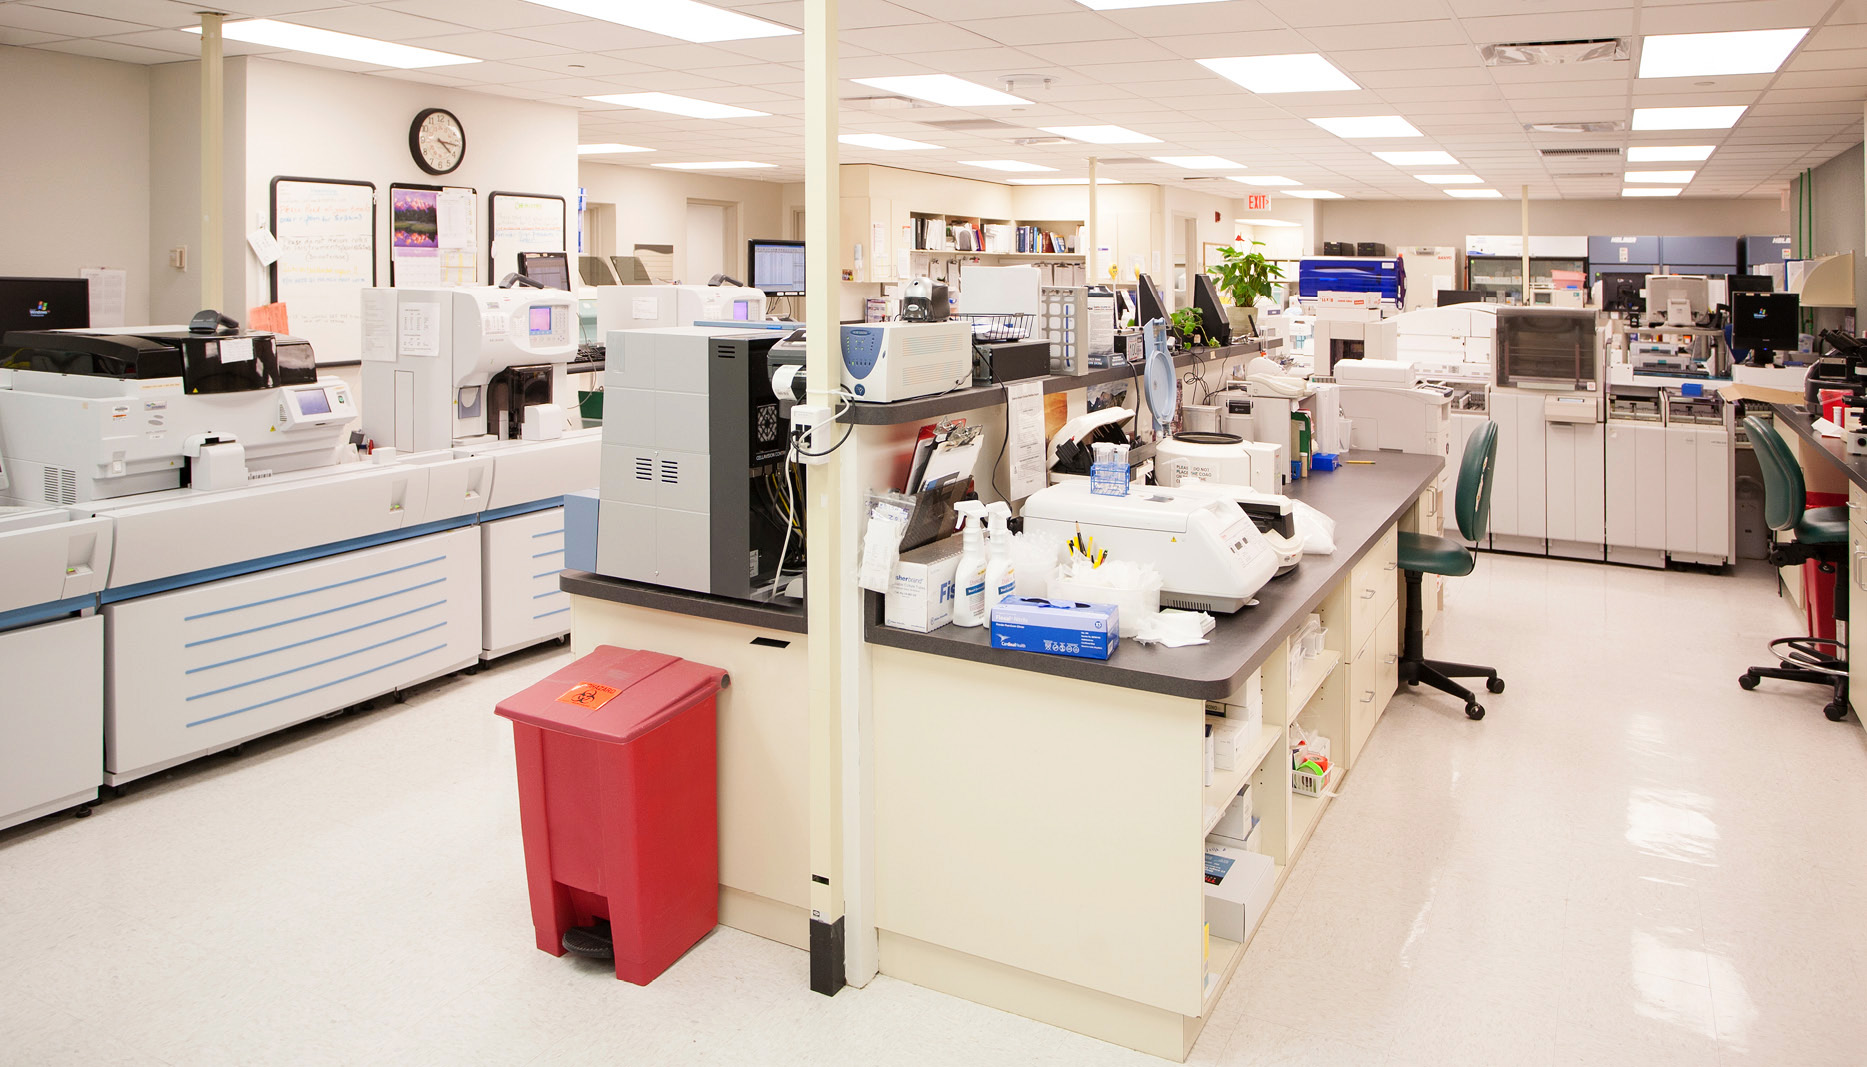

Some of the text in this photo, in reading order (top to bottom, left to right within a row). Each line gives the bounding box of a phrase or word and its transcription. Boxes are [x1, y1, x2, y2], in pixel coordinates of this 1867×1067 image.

[1248, 195, 1266, 209] EXIT
[896, 575, 924, 584] sherbrand
[940, 580, 955, 604] Fis
